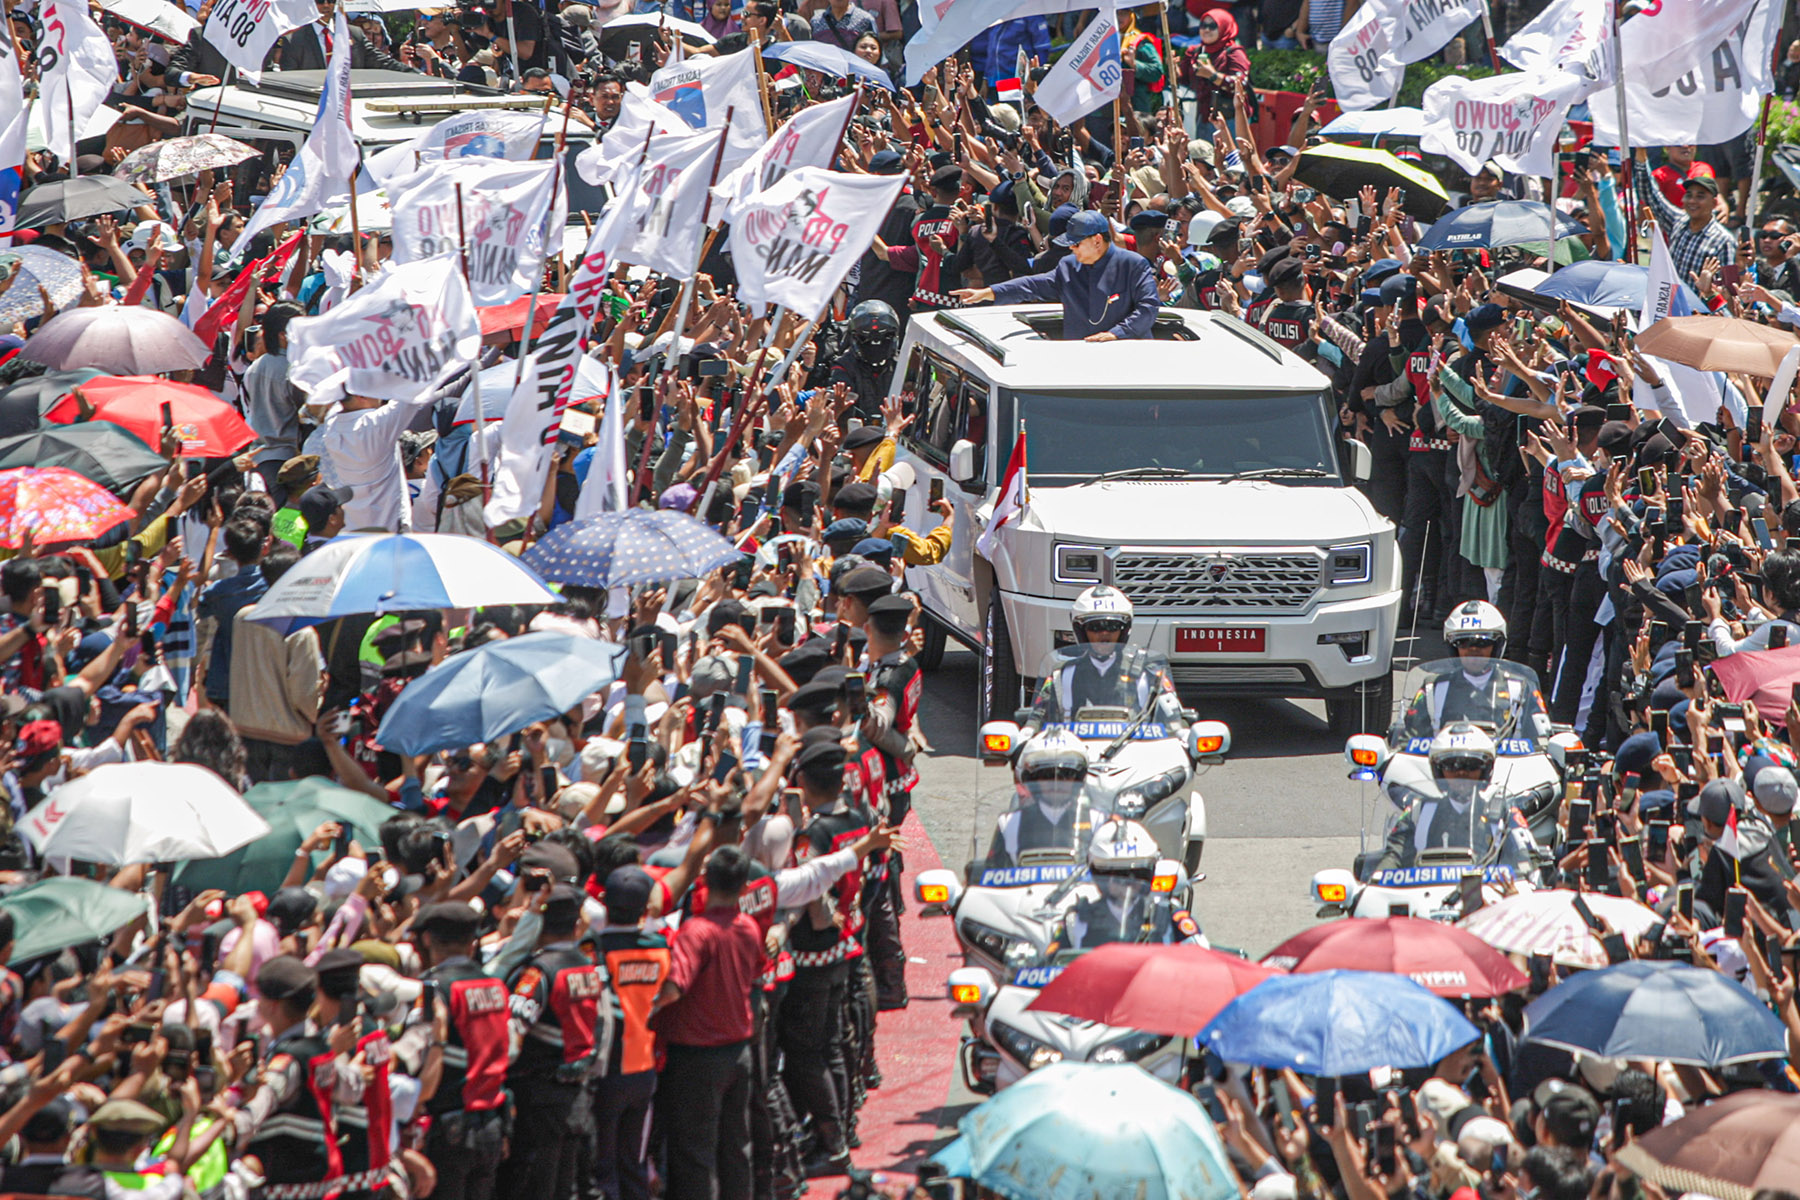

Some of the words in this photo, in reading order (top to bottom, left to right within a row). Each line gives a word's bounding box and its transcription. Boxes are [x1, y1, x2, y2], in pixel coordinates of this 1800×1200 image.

[230, 12, 255, 47] 08
[918, 221, 953, 237] POLISI
[1268, 321, 1300, 340] POLISI
[1183, 629, 1257, 640] INDONESIA
[1218, 641, 1222, 651] 1
[982, 867, 1037, 885] POLISI
[1382, 868, 1438, 884] POLISI
